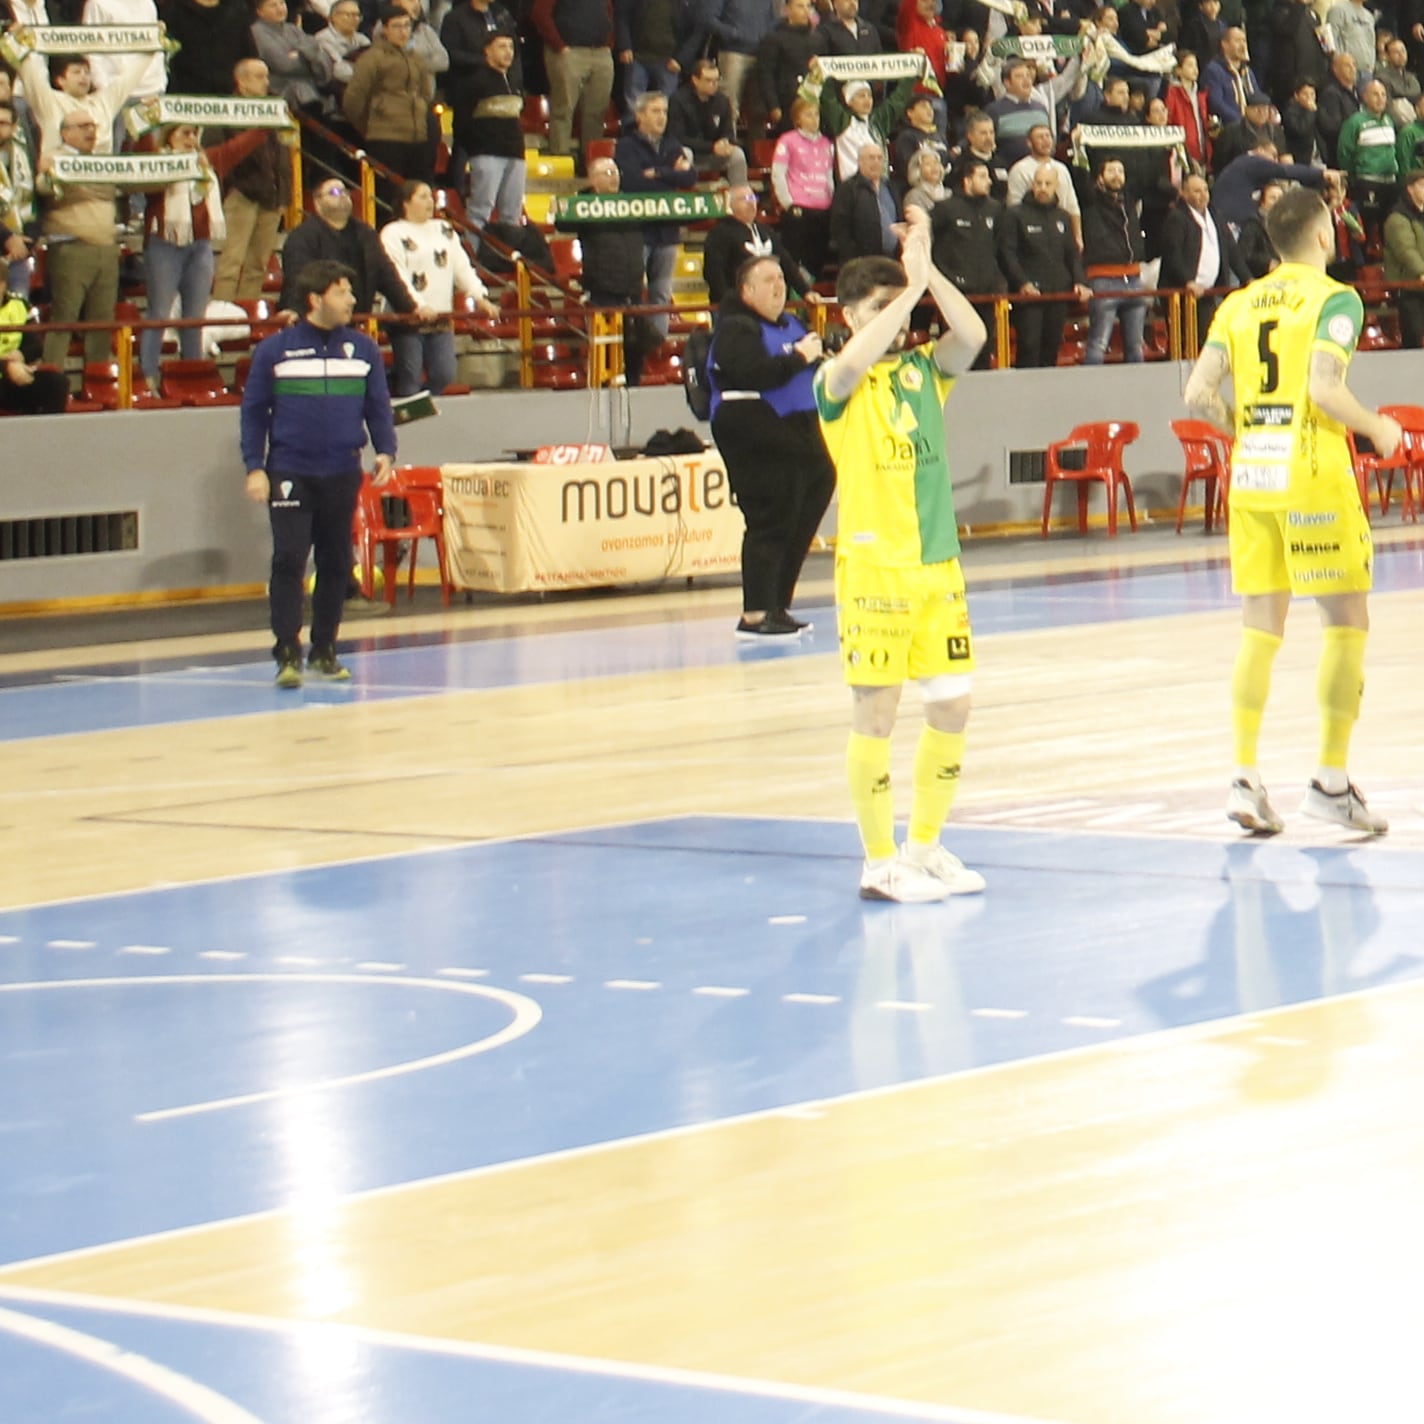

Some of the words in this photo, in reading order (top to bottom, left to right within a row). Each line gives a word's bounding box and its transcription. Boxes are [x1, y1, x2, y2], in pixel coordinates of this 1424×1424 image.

[59, 157, 135, 173] CÓRDOBA
[575, 195, 671, 218] CÓRDOBA
[673, 197, 692, 215] C.
[1258, 320, 1279, 394] 5
